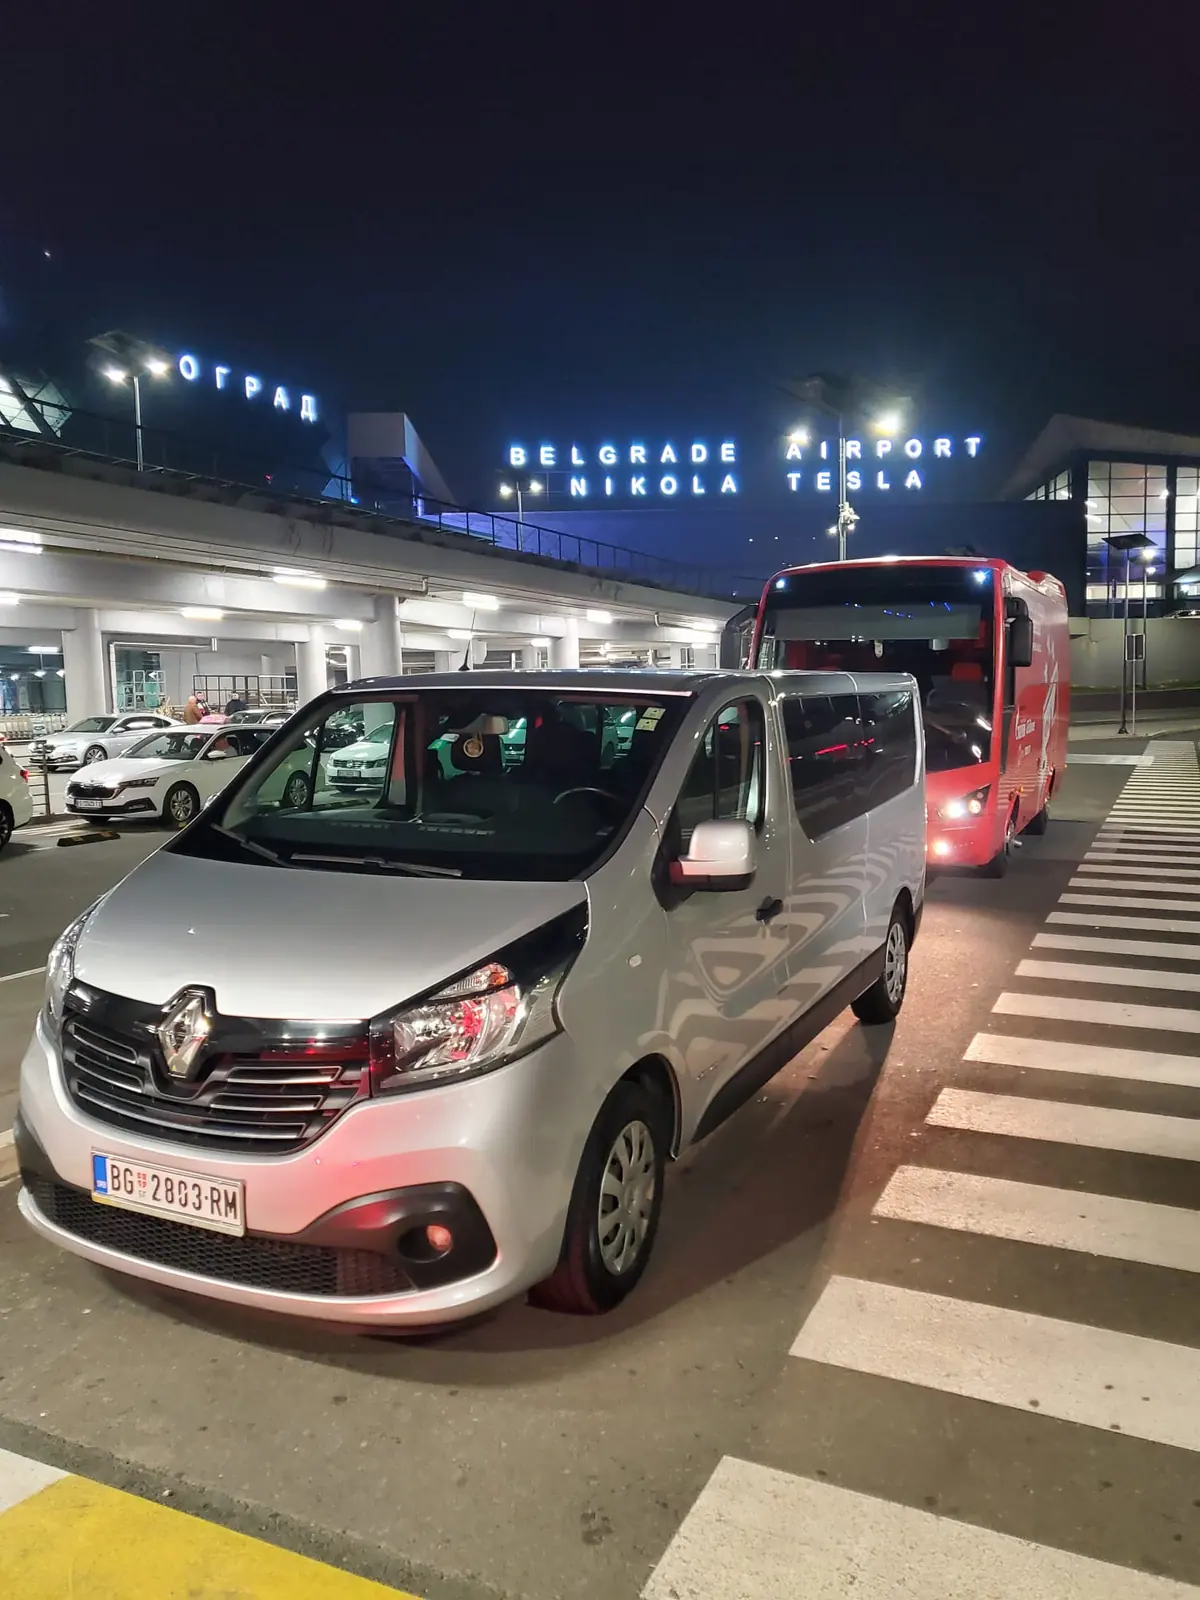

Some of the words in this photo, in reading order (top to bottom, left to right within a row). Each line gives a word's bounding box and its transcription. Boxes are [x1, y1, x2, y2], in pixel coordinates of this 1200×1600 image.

[179, 354, 319, 424] ОГРАД
[509, 443, 736, 466] BELGRADE
[785, 437, 981, 460] AIRPORT
[570, 474, 738, 497] NIKOLA
[786, 469, 922, 491] TESLA
[110, 1163, 134, 1195] BG
